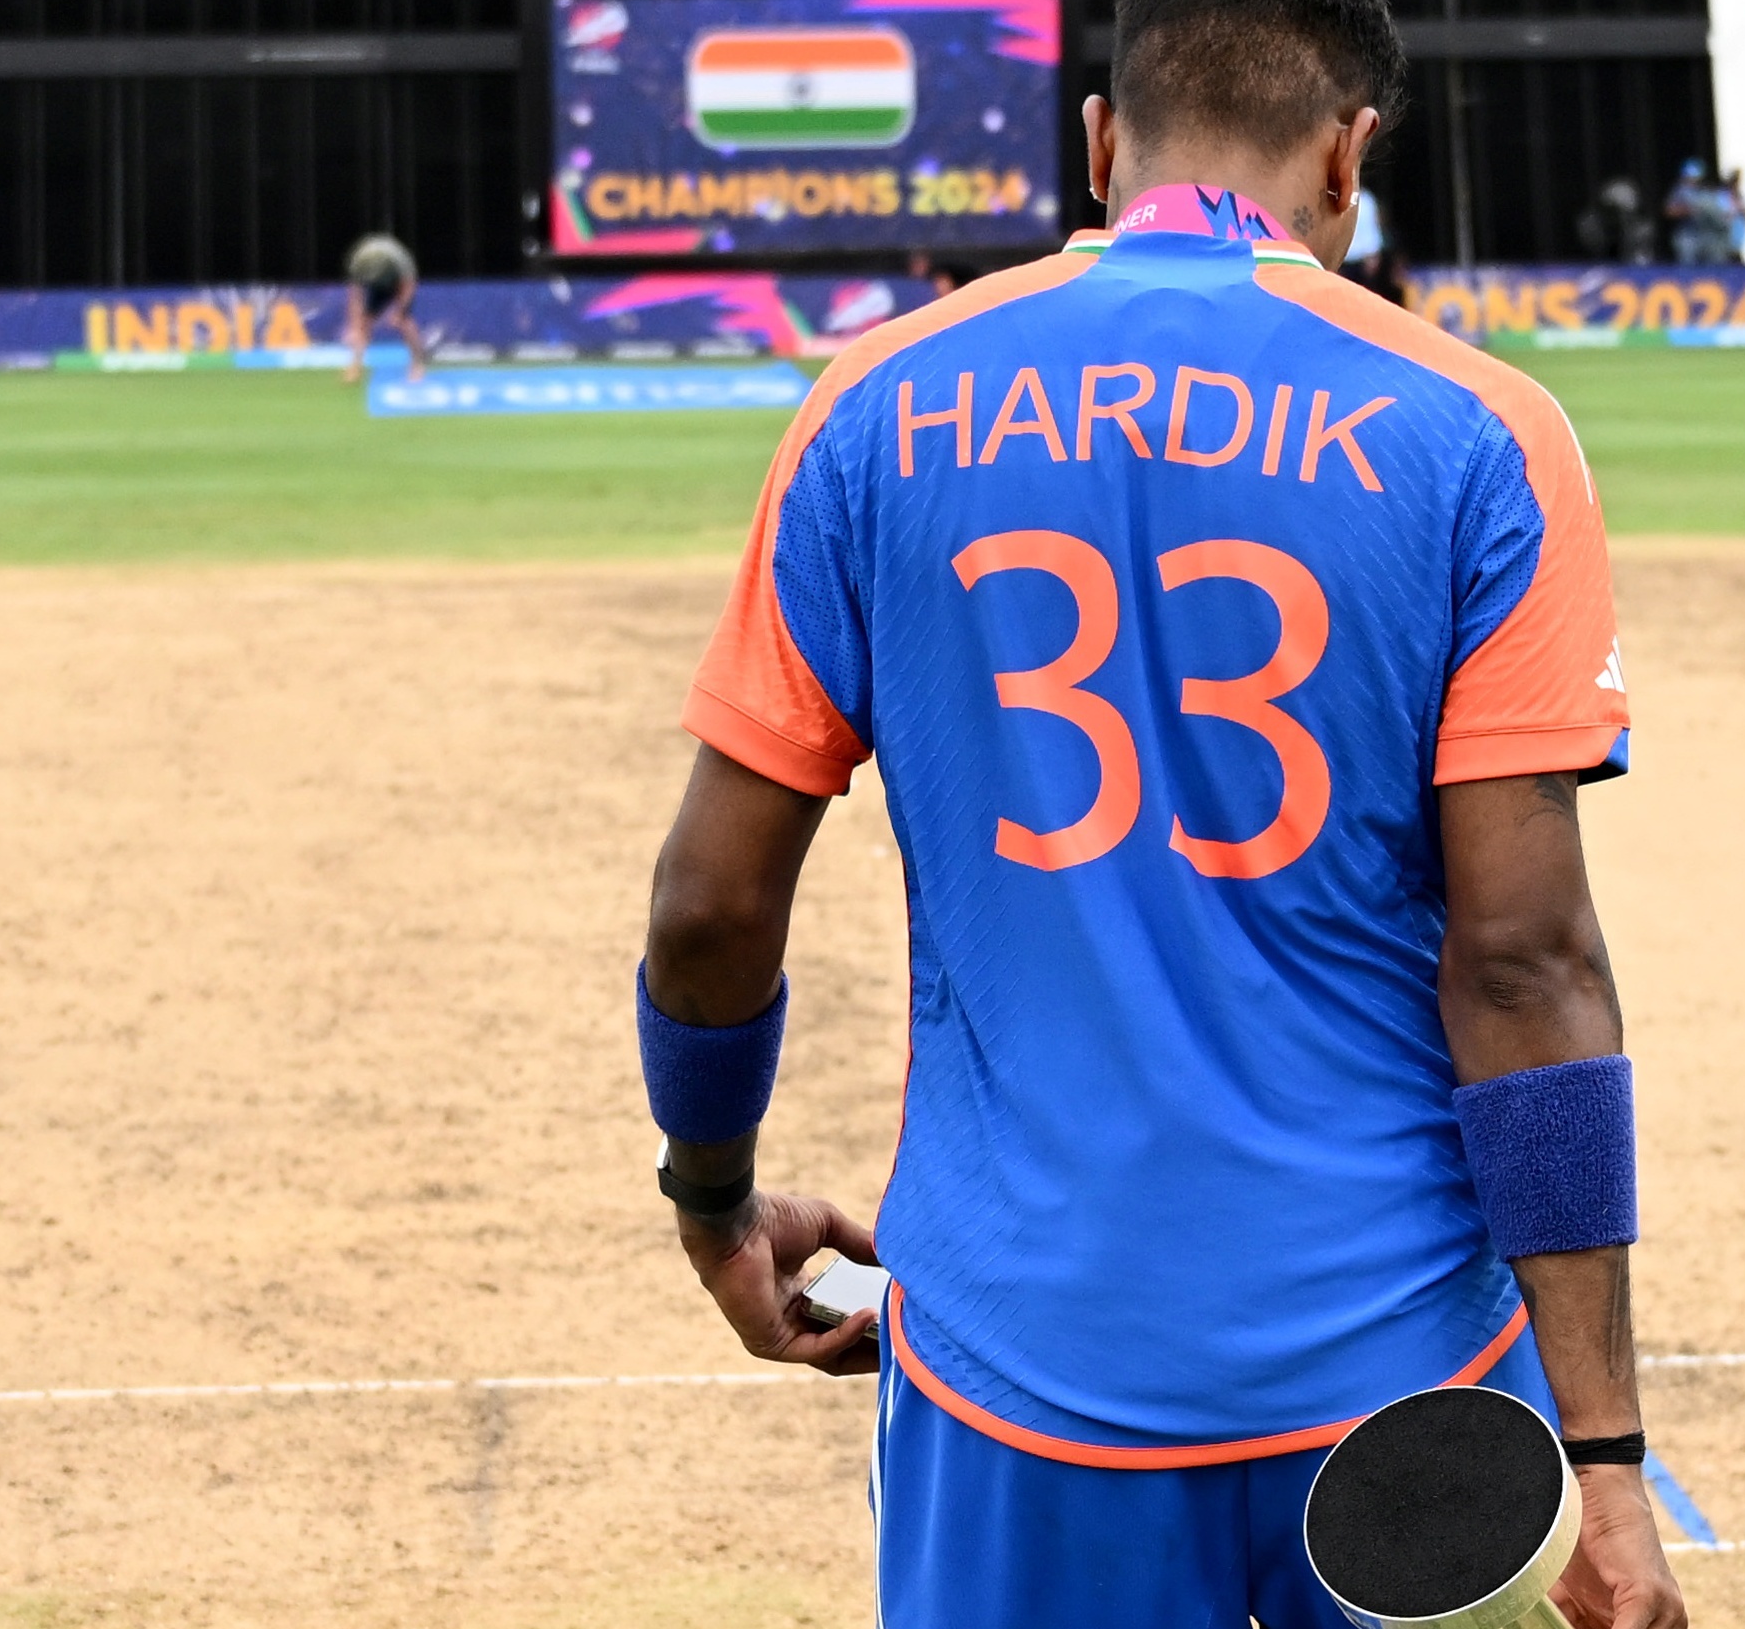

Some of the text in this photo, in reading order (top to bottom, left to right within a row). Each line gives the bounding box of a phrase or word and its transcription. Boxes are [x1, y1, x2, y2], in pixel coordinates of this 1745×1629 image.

[587, 171, 1028, 219] CHAMPIONS 2024
[86, 302, 312, 353] INDIA
[897, 362, 1398, 492] HARDIK
[951, 529, 1331, 879] 33
